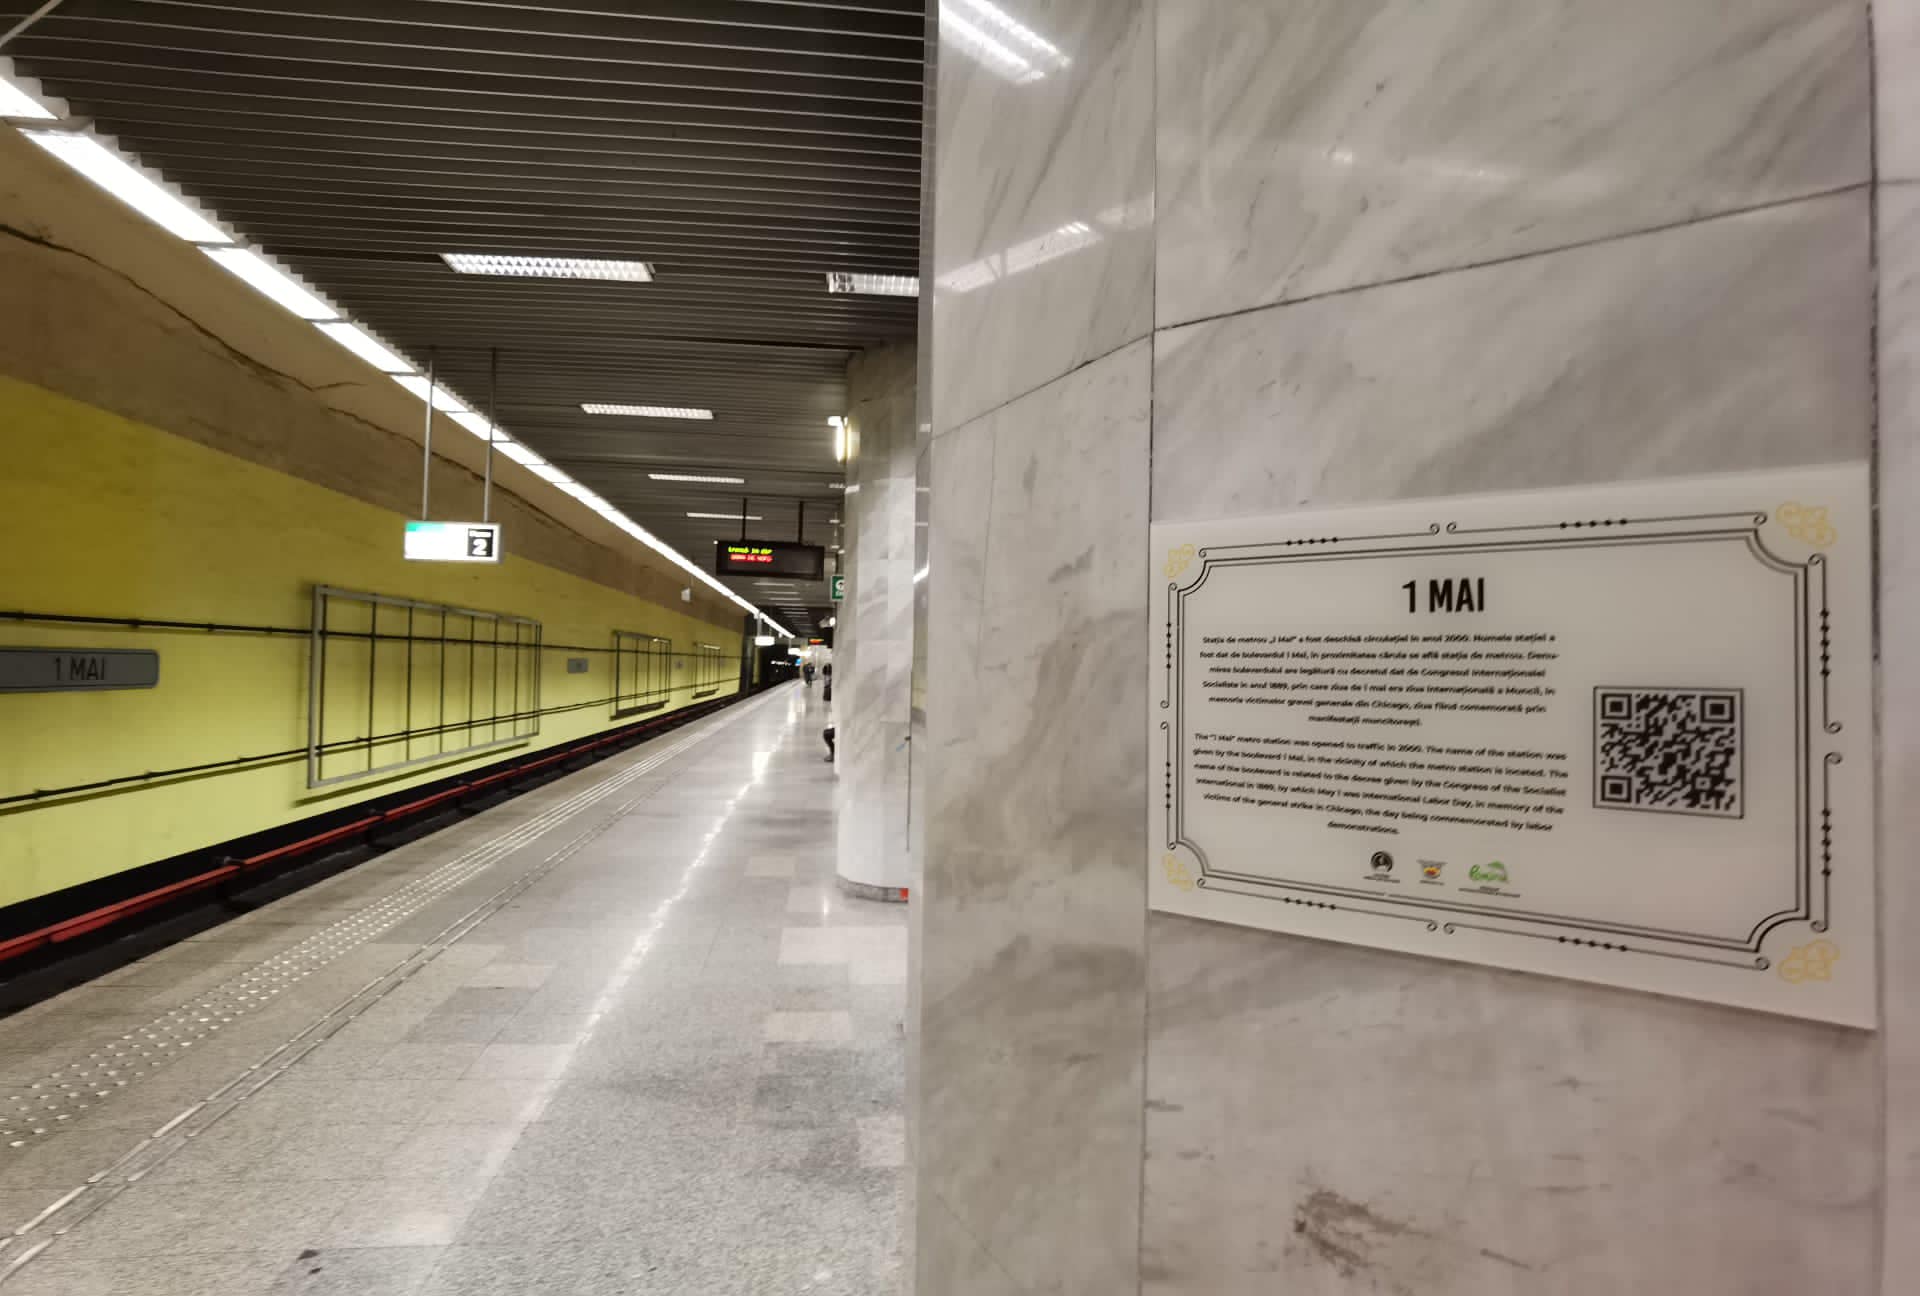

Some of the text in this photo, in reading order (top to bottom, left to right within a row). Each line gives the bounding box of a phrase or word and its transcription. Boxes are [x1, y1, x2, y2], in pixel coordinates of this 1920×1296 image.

[472, 538, 488, 555] 2
[1402, 577, 1485, 613] 1 MAI
[55, 656, 105, 681] 1 MAI
